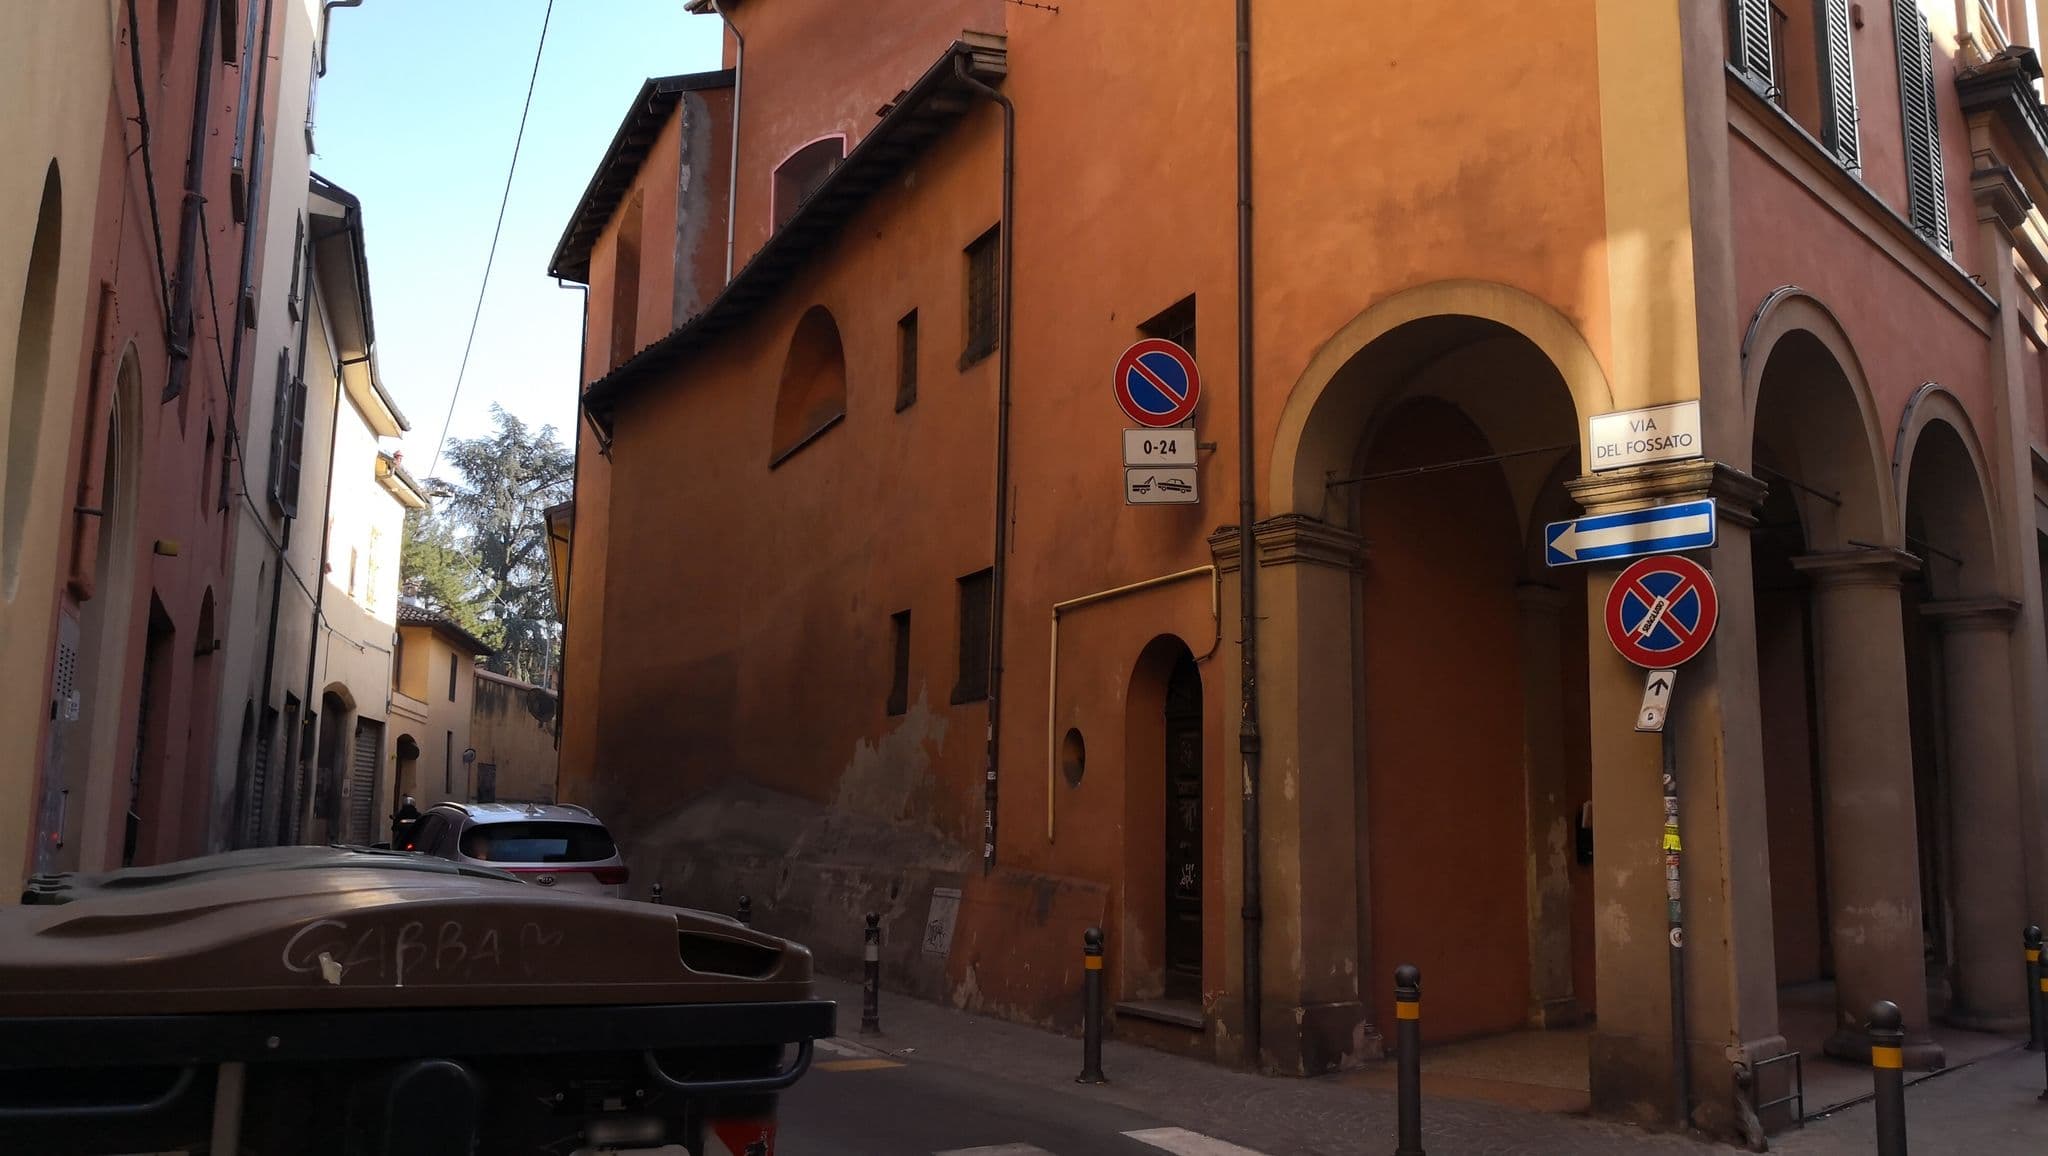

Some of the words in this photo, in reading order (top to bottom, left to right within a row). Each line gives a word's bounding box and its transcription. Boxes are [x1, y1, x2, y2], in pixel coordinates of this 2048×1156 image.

[1630, 418, 1657, 432] VIA
[1144, 440, 1176, 454] 0-24
[1597, 443, 1620, 458] DEL
[1627, 433, 1692, 454] FOSSATO
